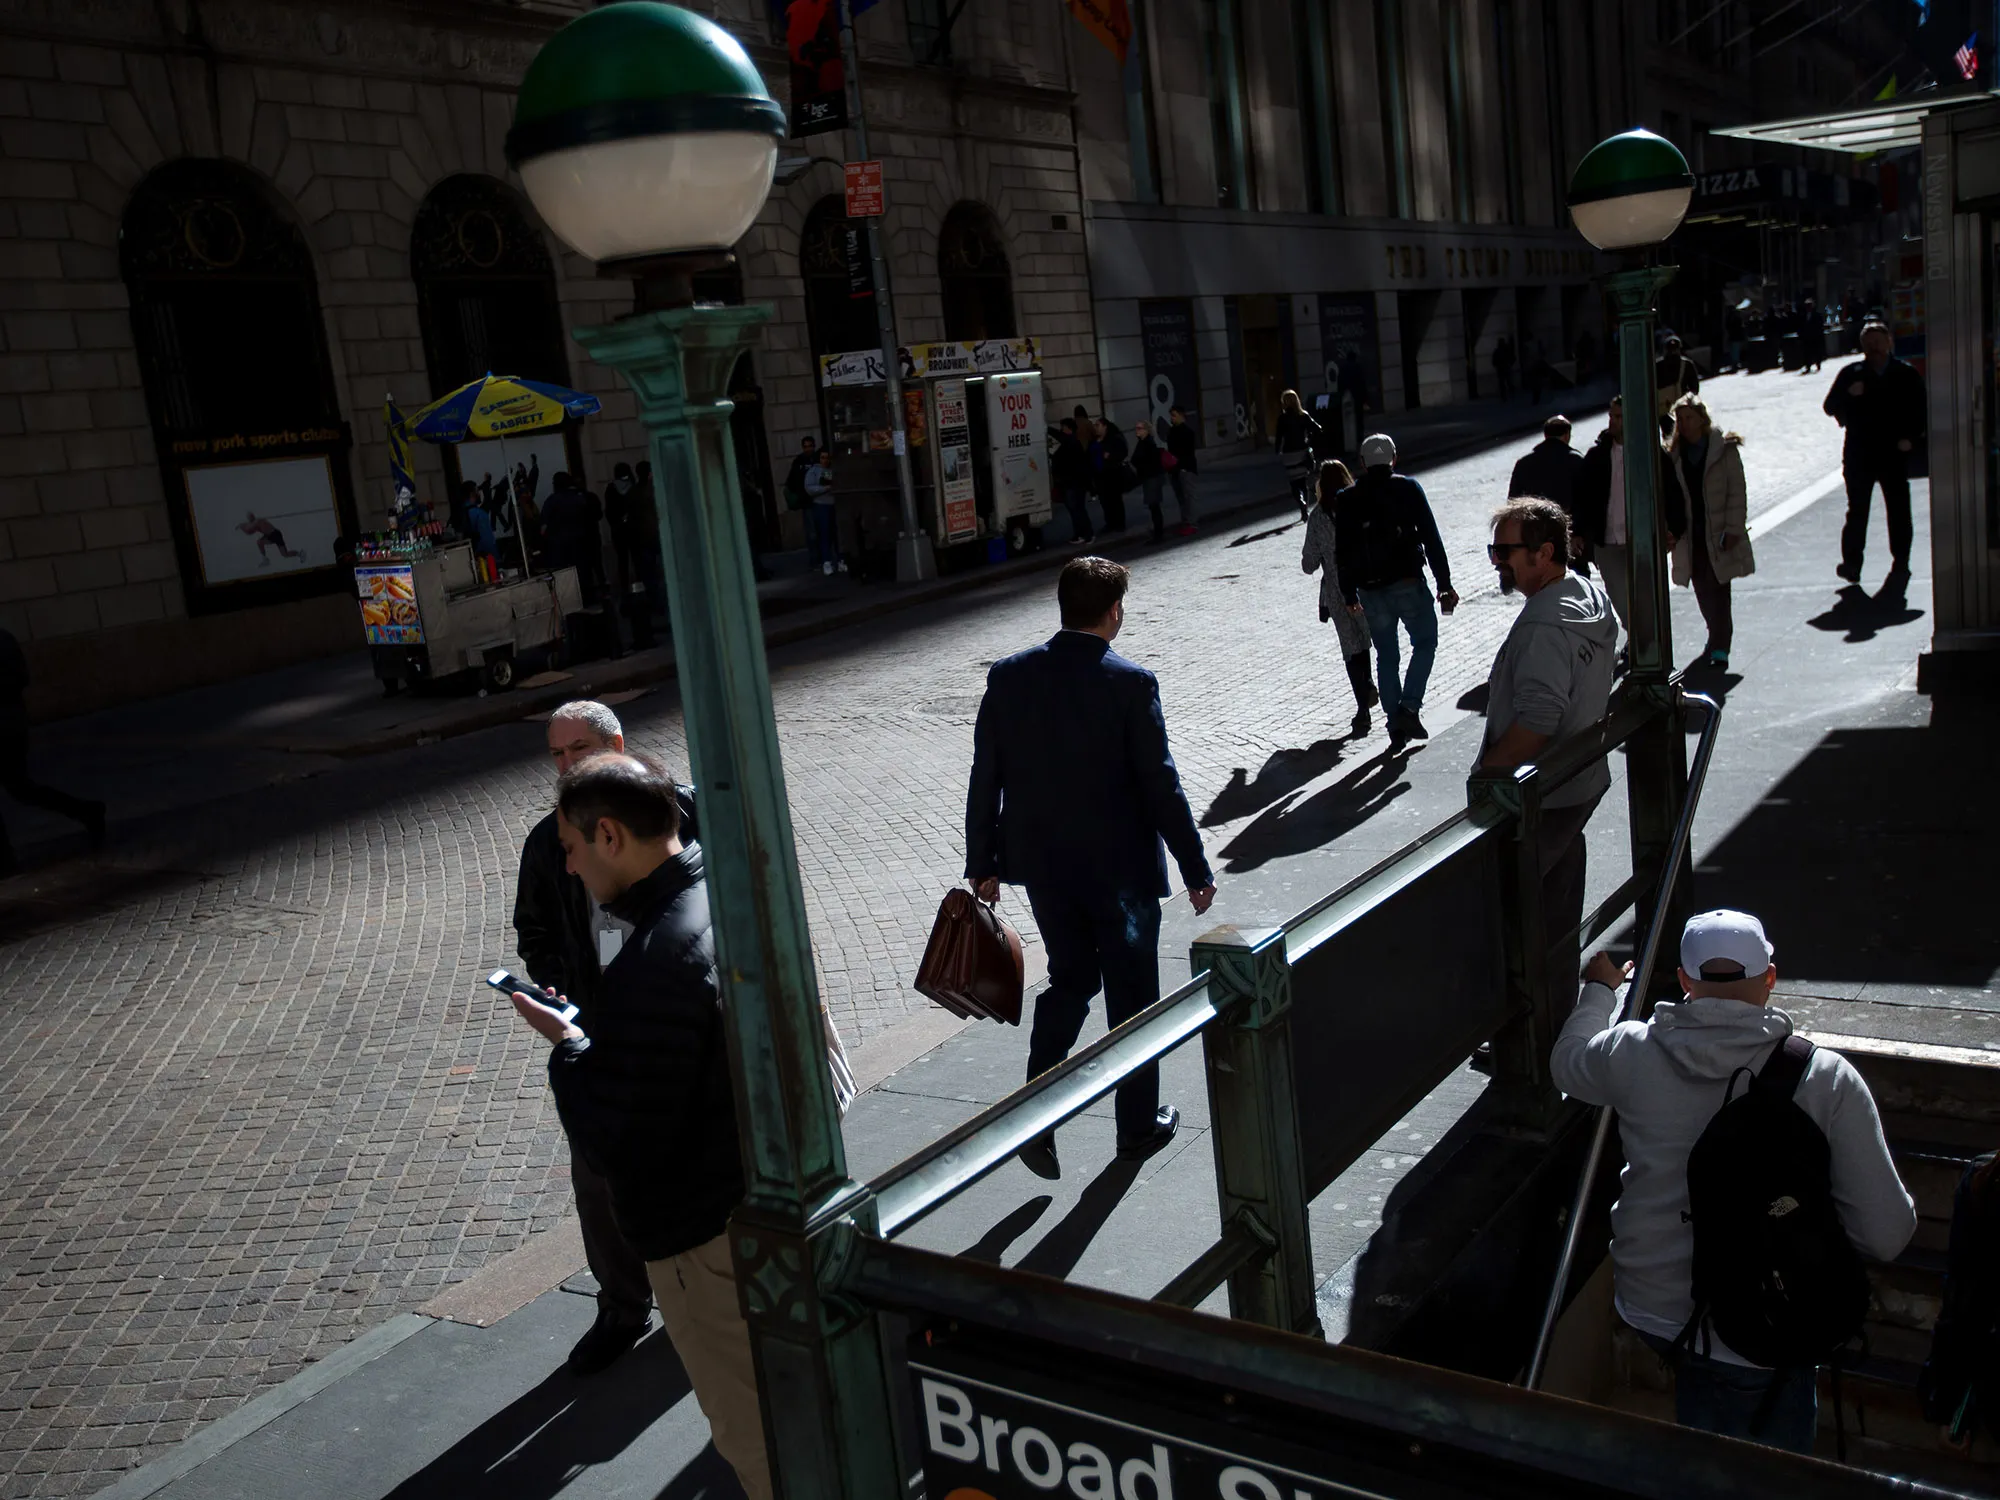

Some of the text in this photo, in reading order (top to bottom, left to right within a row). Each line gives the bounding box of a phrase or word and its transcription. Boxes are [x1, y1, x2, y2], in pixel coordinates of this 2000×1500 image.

[1700, 167, 1761, 196] IZZA
[1926, 153, 1949, 280] Newsstand
[1386, 245, 1426, 279] THE
[1000, 394, 1032, 412] YOUR
[490, 412, 543, 432] SABRETT
[1011, 413, 1027, 430] AD
[212, 433, 247, 453] york
[250, 429, 299, 449] sports
[1008, 434, 1031, 448] HERE
[921, 1376, 1173, 1500] Broad
